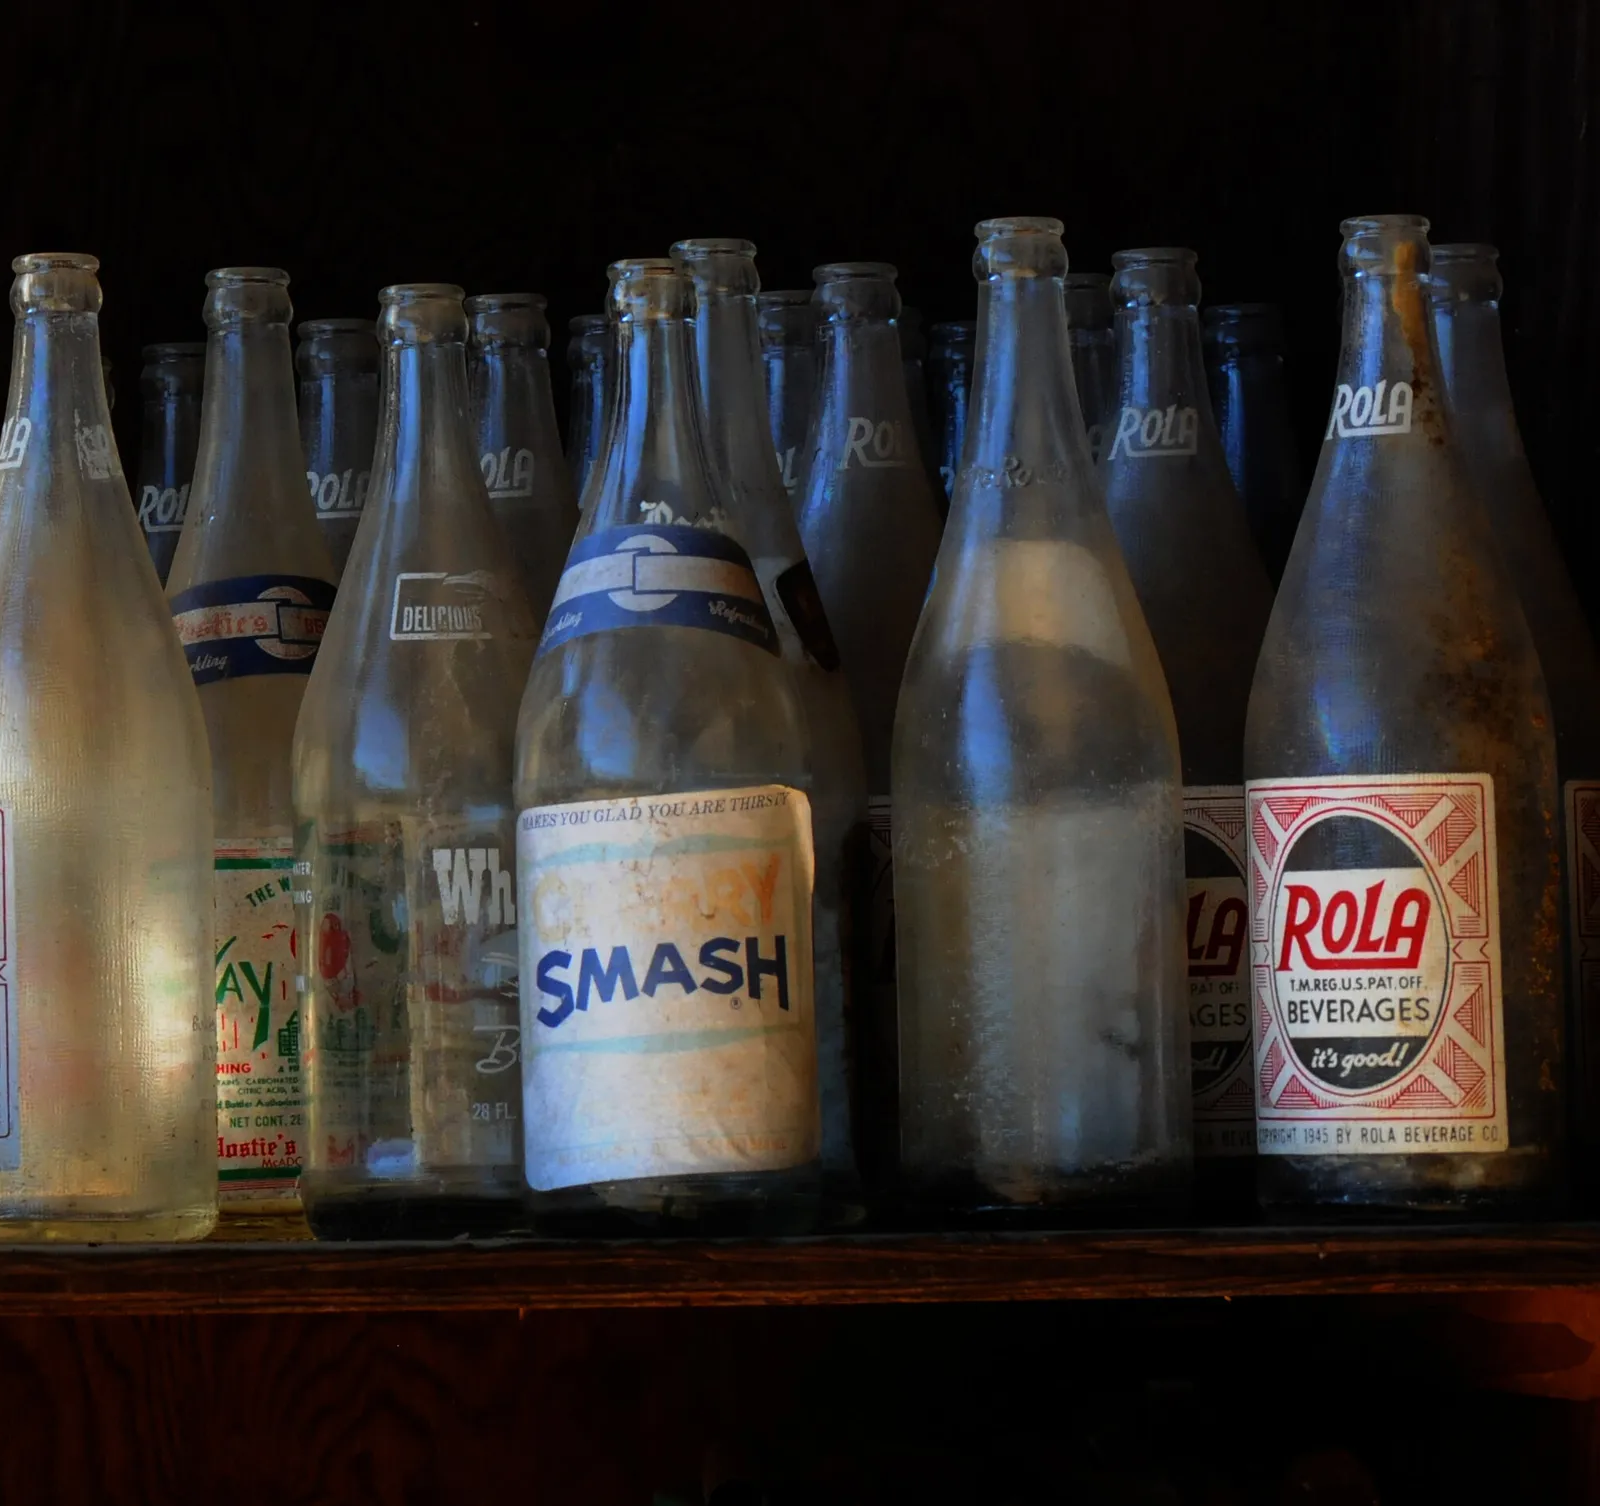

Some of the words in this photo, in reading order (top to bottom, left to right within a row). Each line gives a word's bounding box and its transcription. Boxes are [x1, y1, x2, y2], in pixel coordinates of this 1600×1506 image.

[1324, 379, 1413, 441] ROLA
[1107, 404, 1198, 460] ROLA
[481, 446, 534, 498] OLA
[138, 484, 190, 533] ROL
[402, 604, 483, 632] DELICIOUS
[190, 655, 228, 674] rkling
[522, 812, 557, 831] MAKES
[558, 809, 591, 827] YOU
[594, 805, 643, 824] GLAD
[647, 800, 685, 818] YOU
[689, 797, 726, 815] ARE
[729, 791, 790, 812] THIRSTY
[245, 882, 276, 908] THE
[1187, 890, 1248, 977] LA
[1275, 879, 1431, 972] ROLA
[536, 934, 790, 1029] SMASH
[1288, 997, 1430, 1024] BEVERAGES
[1311, 1047, 1338, 1069] it's
[1339, 1042, 1410, 1078] good!
[229, 1116, 250, 1129] NET
[255, 1115, 289, 1128] CONT.
[472, 1102, 490, 1121] 28
[495, 1102, 517, 1120] FL.
[1303, 1126, 1329, 1145] 1945
[1336, 1127, 1352, 1144] BY
[1360, 1126, 1397, 1143] ROLA
[1404, 1125, 1475, 1143] BEVERAGE
